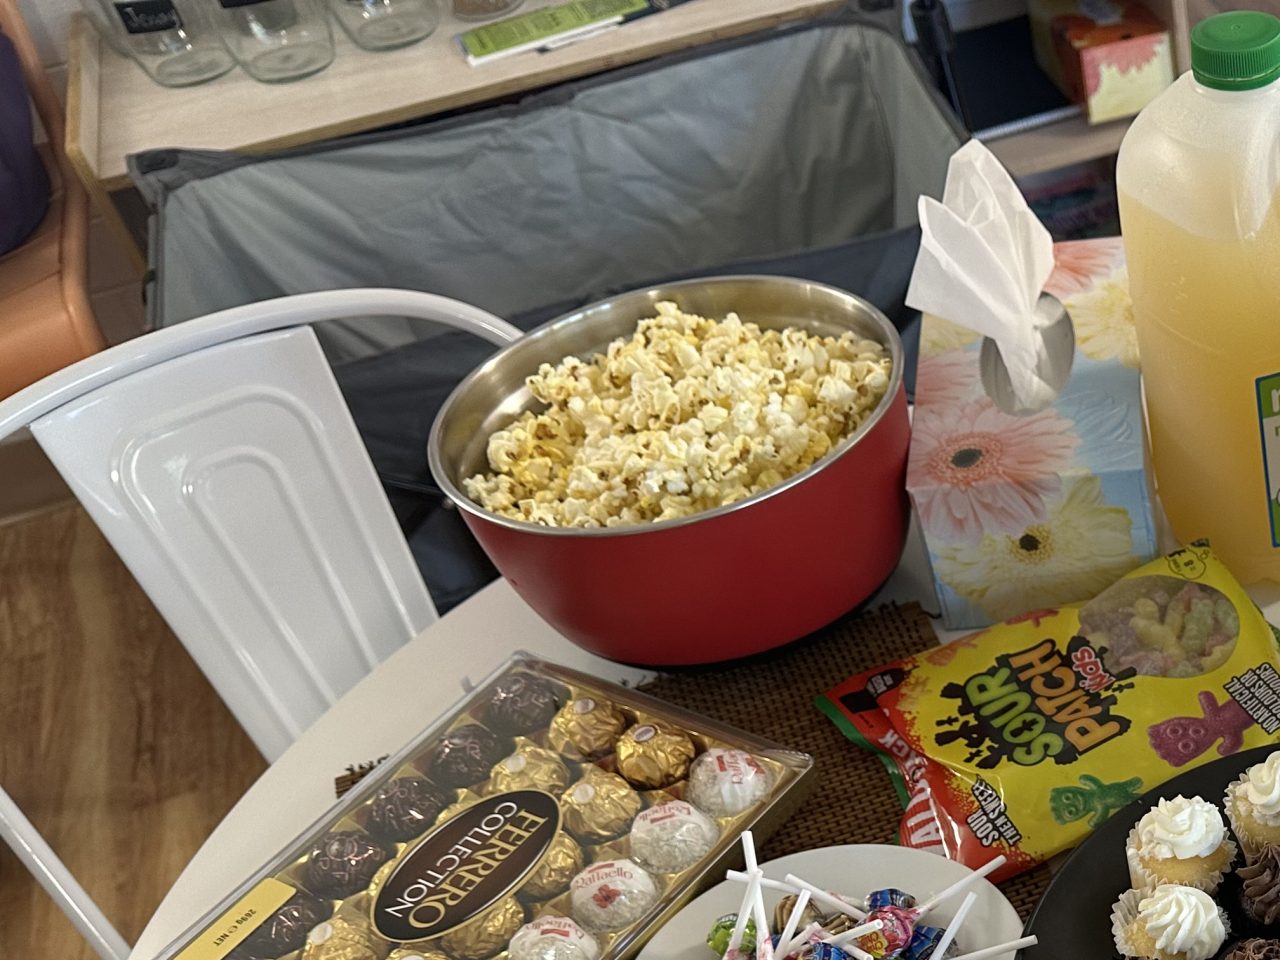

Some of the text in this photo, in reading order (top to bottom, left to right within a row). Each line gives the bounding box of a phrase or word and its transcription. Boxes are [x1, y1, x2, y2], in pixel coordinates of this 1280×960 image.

[1008, 641, 1121, 752] PATCH
[1240, 669, 1259, 688] OR
[966, 667, 1064, 766] SOUR
[1224, 677, 1273, 723] ARTIFICIAL
[968, 808, 999, 847] SOUR
[994, 814, 1022, 847] THEN
[384, 801, 518, 918] COLLECTION
[408, 808, 549, 929] FERRERO
[575, 867, 634, 890] Raffaello
[212, 933, 230, 947] NET
